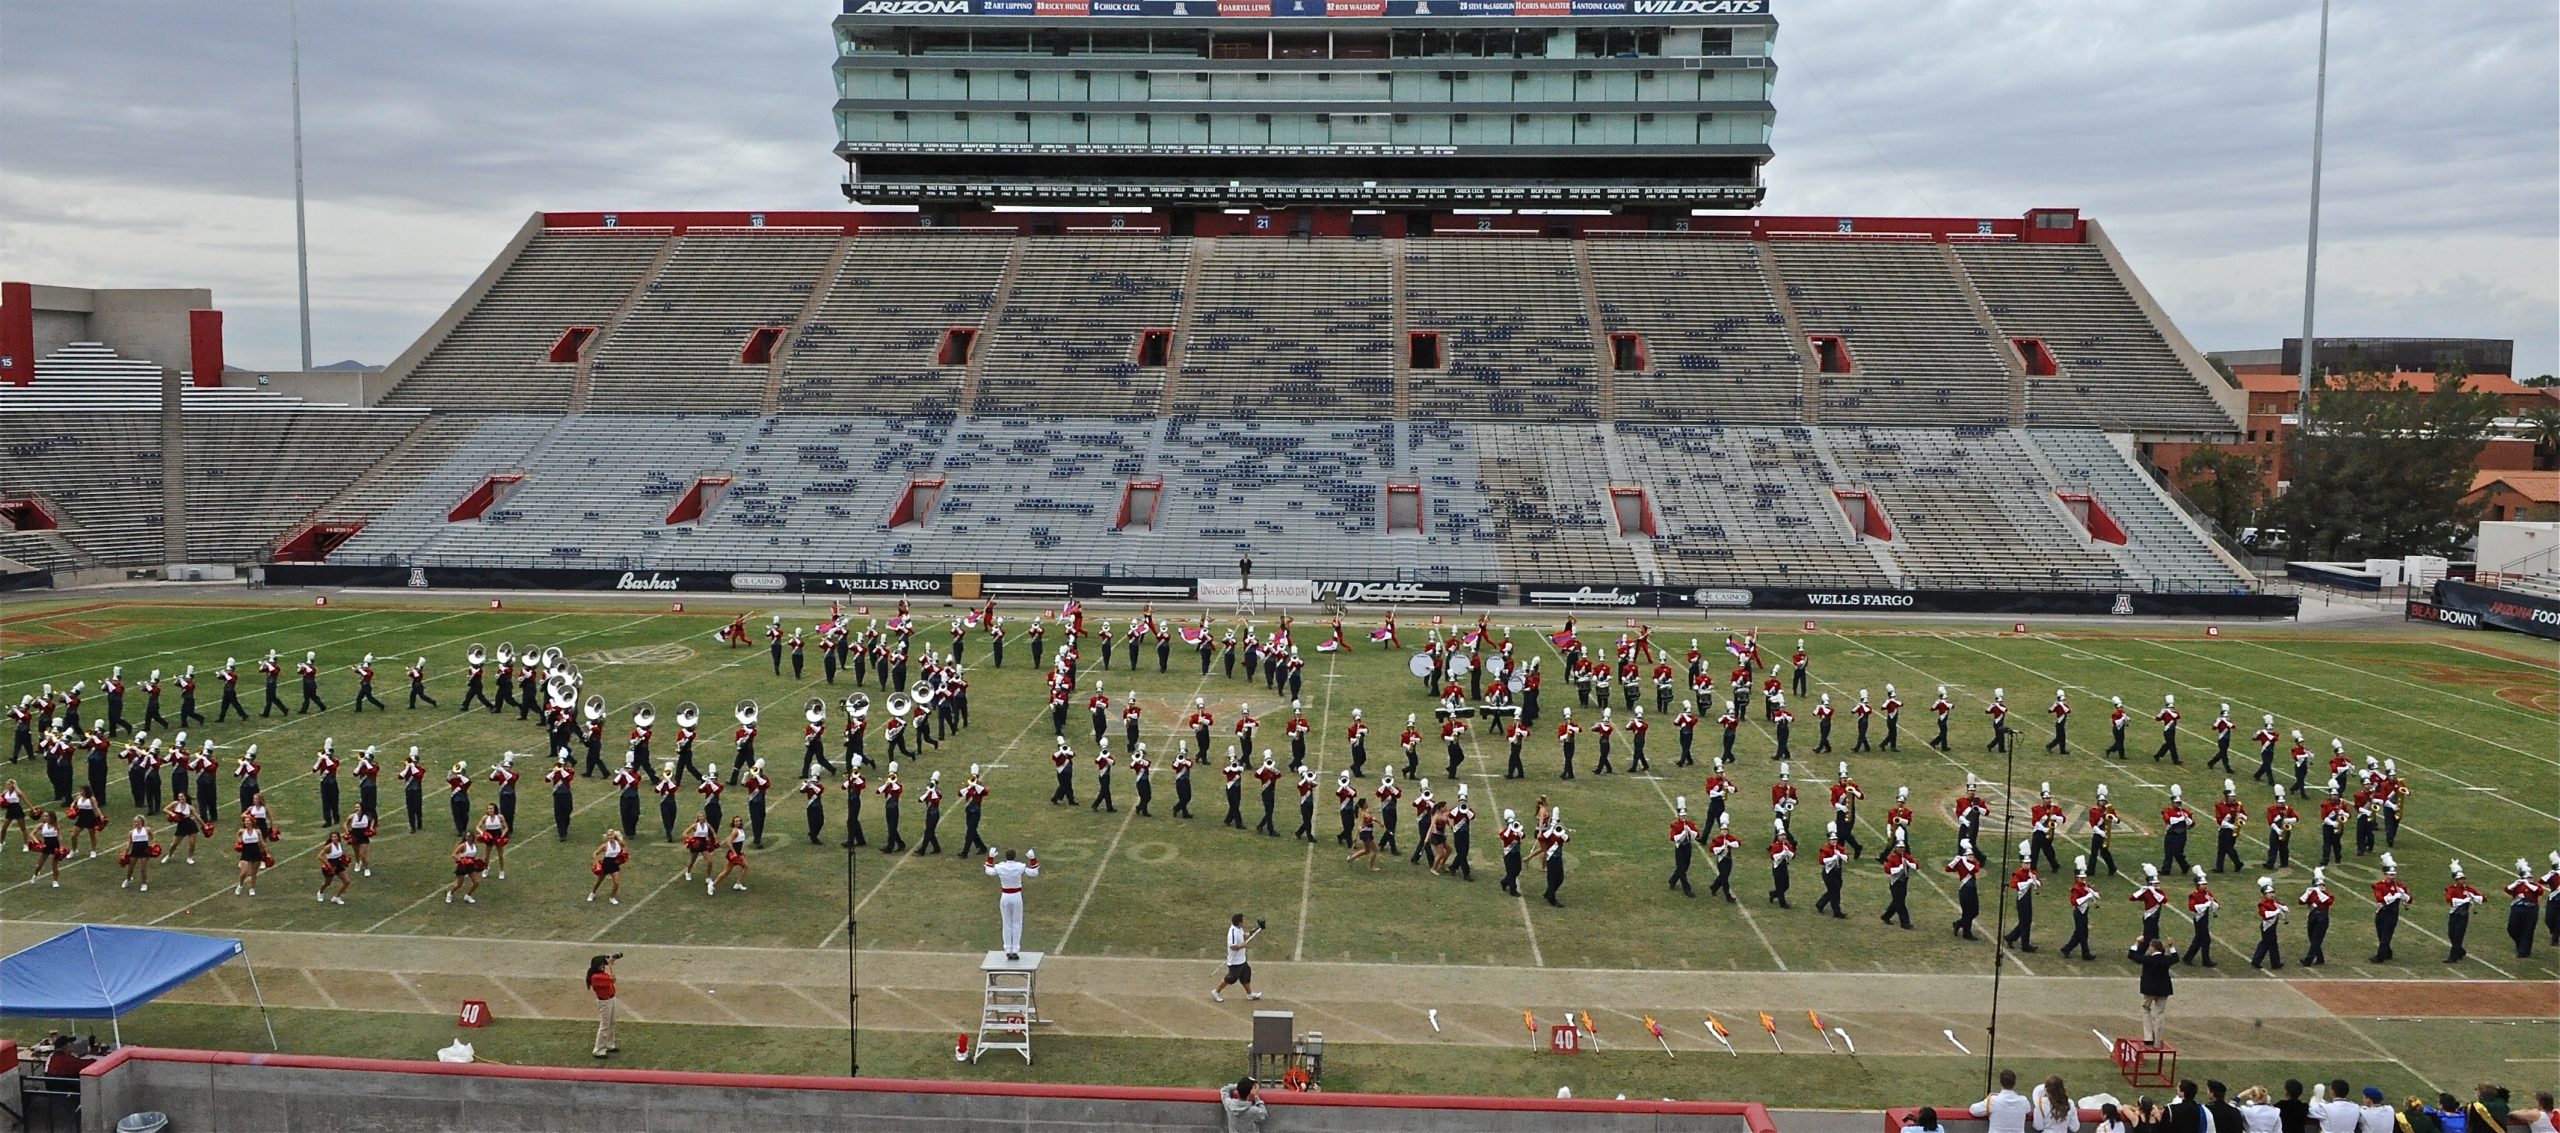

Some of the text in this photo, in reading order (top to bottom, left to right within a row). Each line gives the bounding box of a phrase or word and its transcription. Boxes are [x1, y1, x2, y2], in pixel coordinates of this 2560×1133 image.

[856, 1, 969, 14] ARIZONA
[1634, 1, 1761, 14] WILDCATS
[606, 219, 616, 228] 17
[752, 219, 763, 228] 18
[920, 219, 931, 228] 19
[1111, 219, 1124, 228] 20
[1257, 219, 1269, 228] 21
[1478, 221, 1491, 230] 22
[1676, 222, 1688, 231] 23
[1838, 224, 1852, 233] 24
[1978, 224, 1992, 234] 25
[2, 358, 12, 367] 15
[258, 376, 268, 384] 16
[408, 568, 428, 586] A
[616, 572, 680, 590] Bashas'
[838, 580, 940, 590] WELLS FARGO
[1200, 586, 1234, 596] UNIVERSITY
[1276, 586, 1294, 596] BAND
[1296, 586, 1308, 596] DAY
[1312, 582, 1424, 602] WILDCATS
[1576, 586, 1640, 606] Bhas'
[1808, 594, 1914, 606] WELLS FARGO
[2112, 594, 2134, 614] A
[2410, 604, 2477, 627] BEAR DOWN
[2490, 602, 2532, 619] ARIZONA
[461, 1004, 480, 1024] 40
[1555, 1030, 1574, 1050] 40
